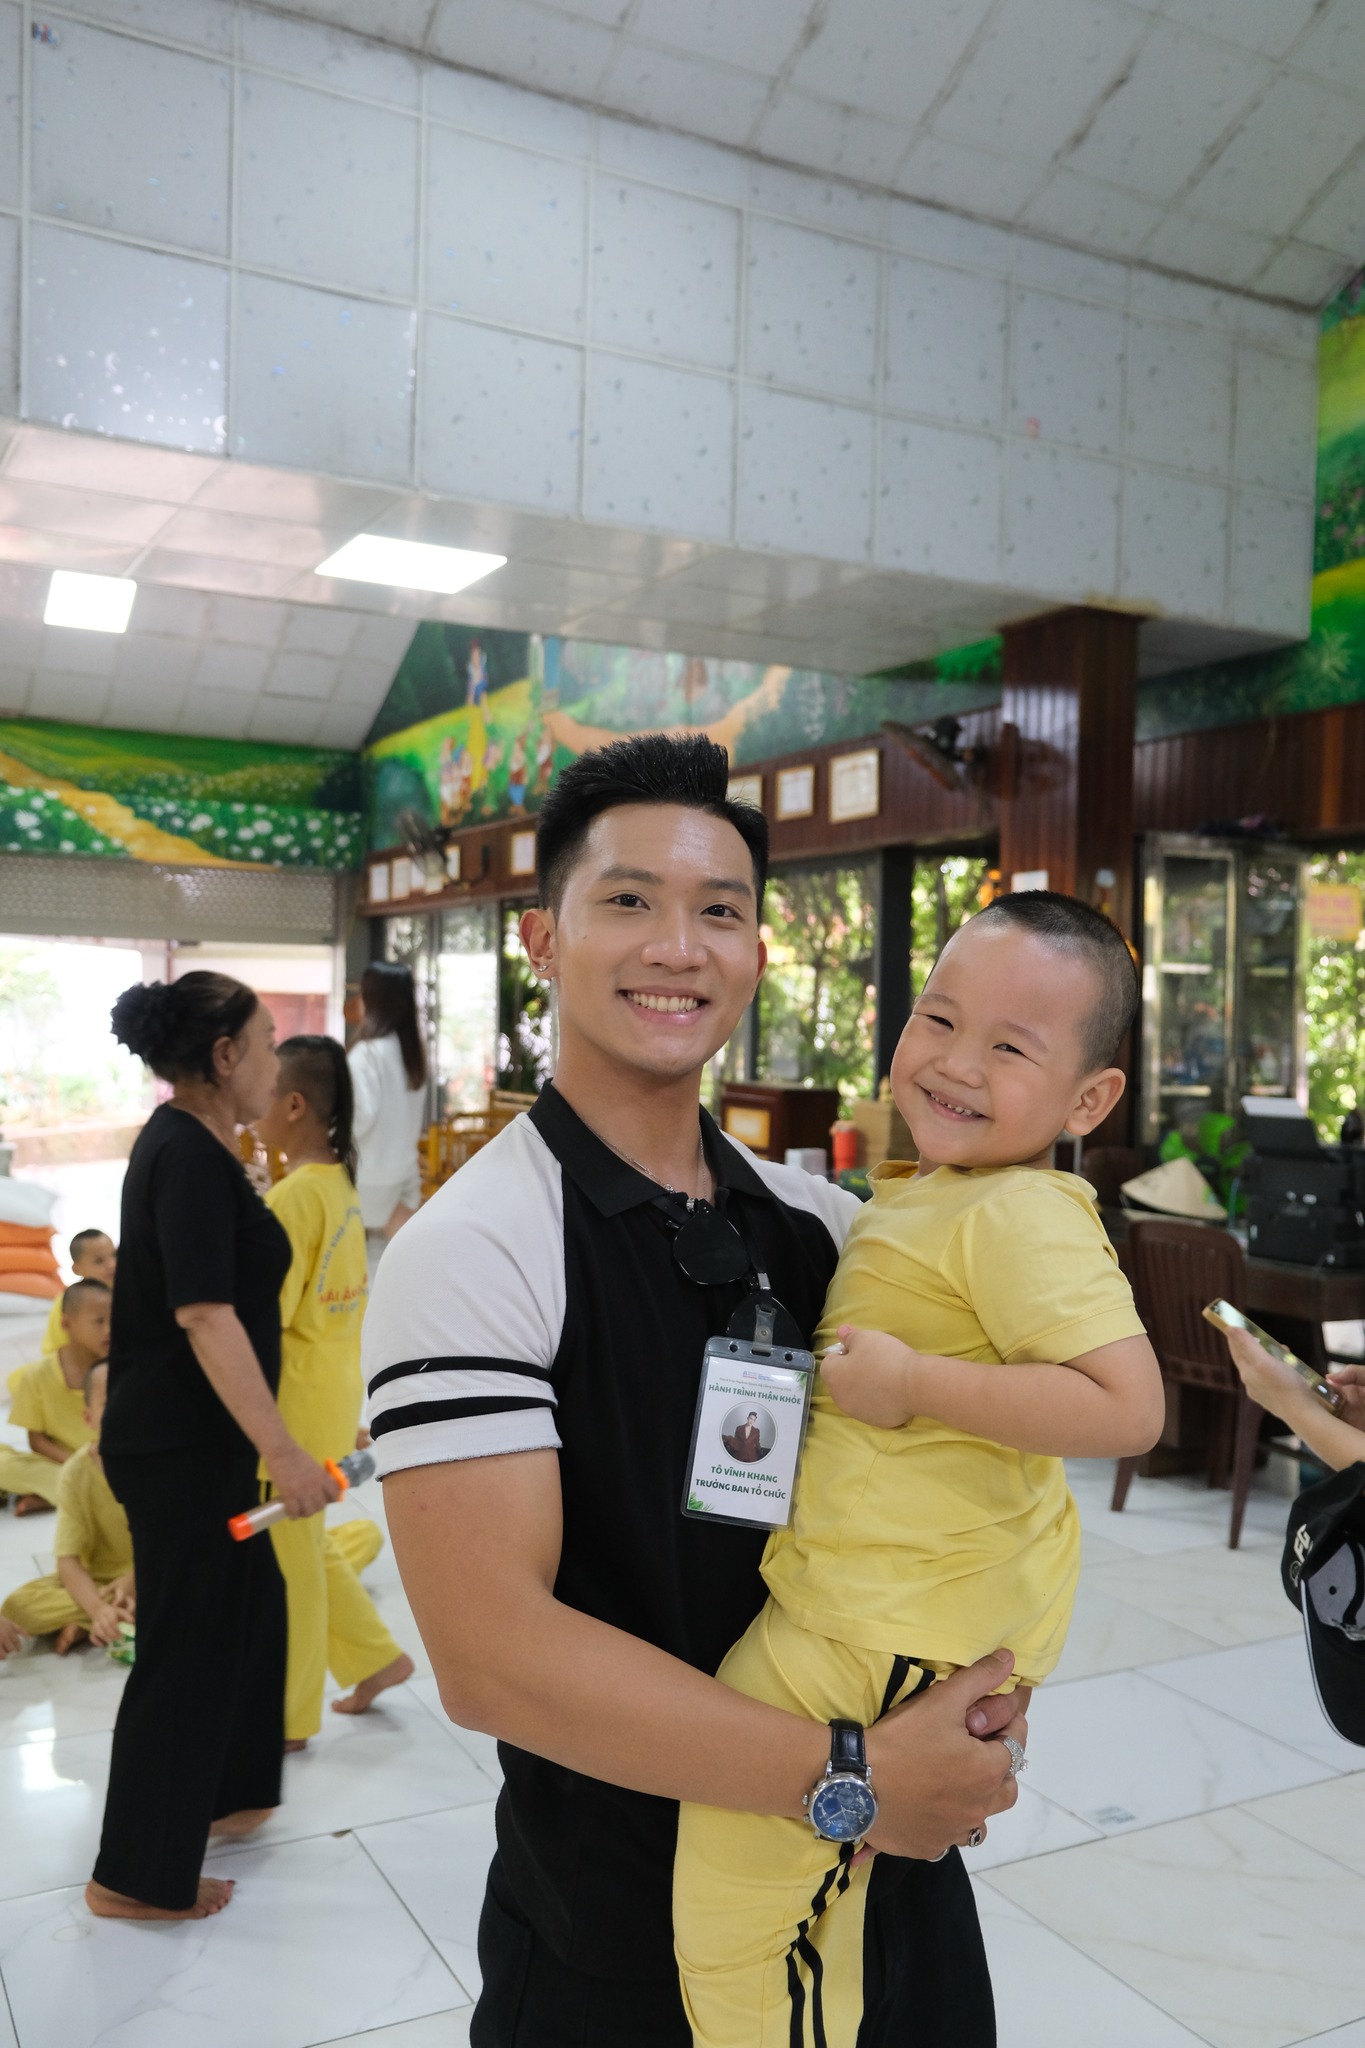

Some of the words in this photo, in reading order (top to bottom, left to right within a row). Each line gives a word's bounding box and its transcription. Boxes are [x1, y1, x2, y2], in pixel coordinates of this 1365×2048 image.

[708, 1382, 732, 1394] HÀNH
[732, 1386, 757, 1397] TRÌNH
[757, 1390, 779, 1402] THẬN
[711, 1464, 723, 1474] TÔ
[723, 1466, 746, 1478] VĨNH
[747, 1471, 778, 1483] KHANG
[695, 1478, 730, 1491] TRƯỞNG
[731, 1484, 750, 1494] BAN
[751, 1483, 762, 1495] TỔ
[763, 1488, 787, 1500] CHỨC
